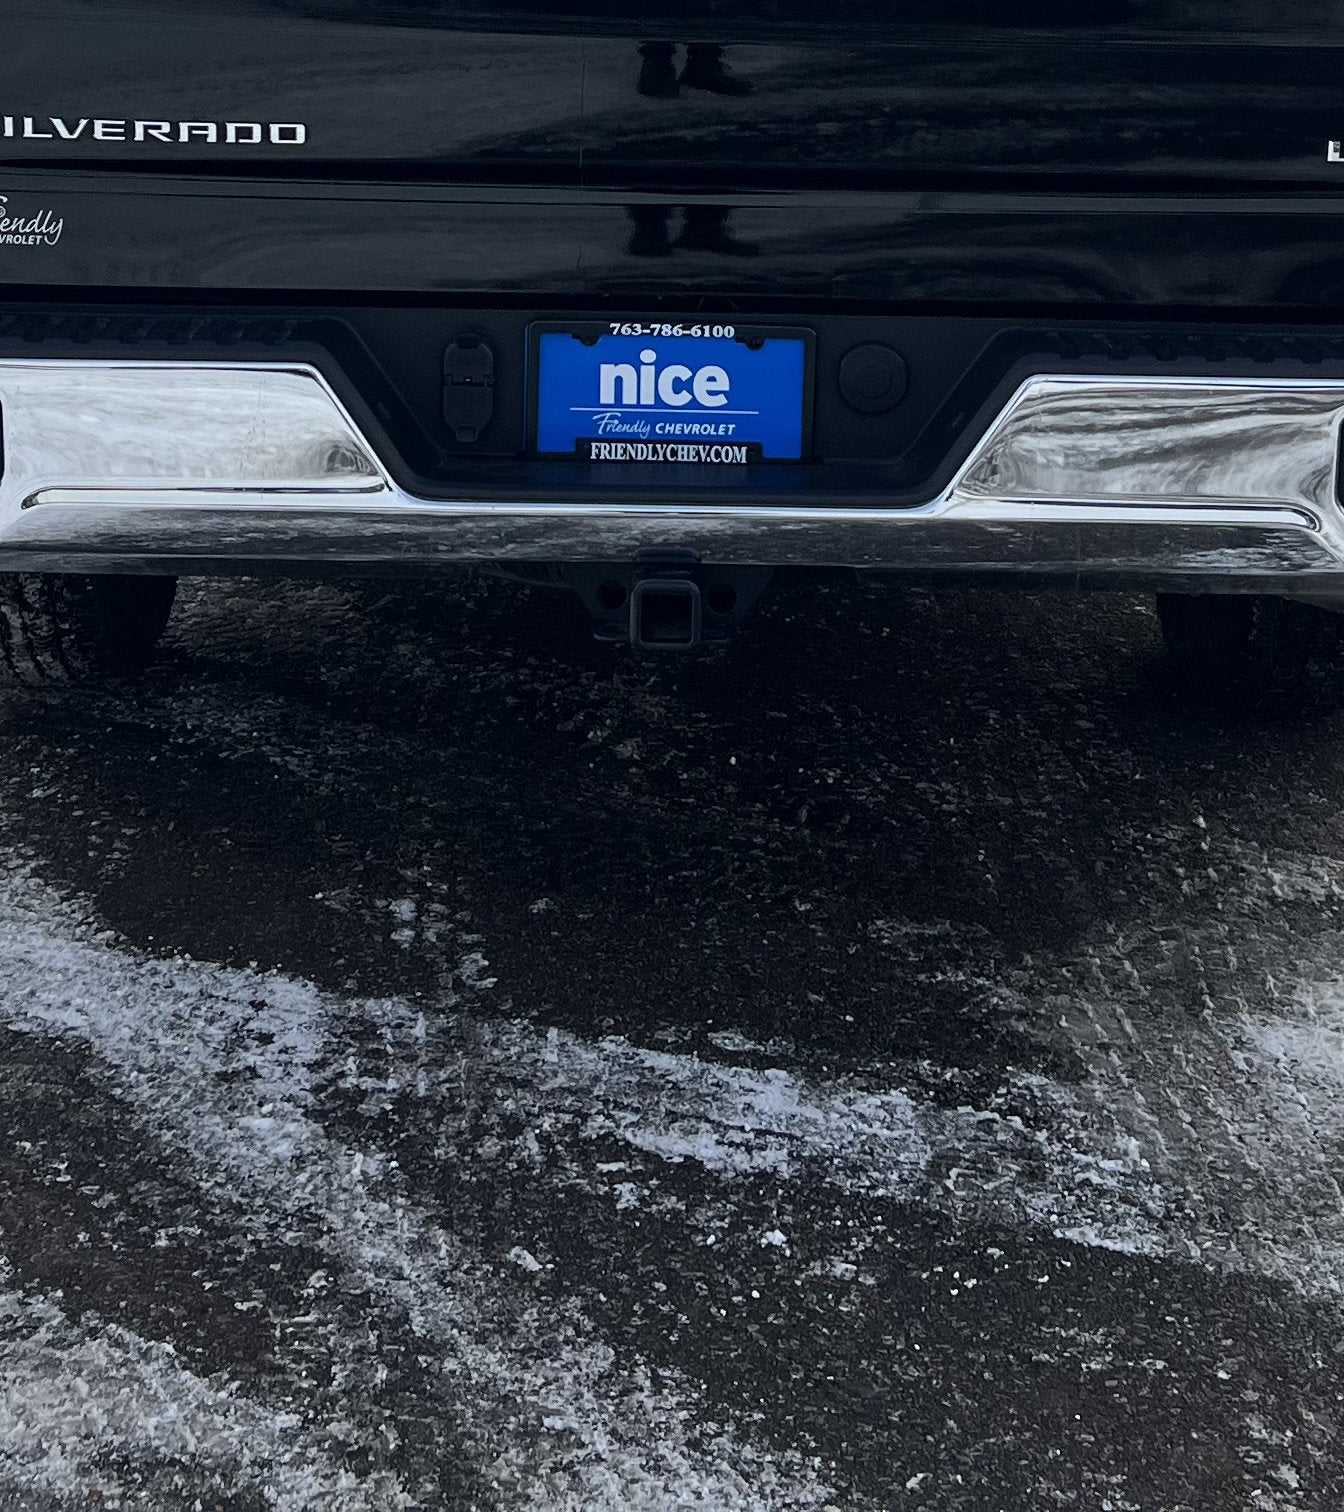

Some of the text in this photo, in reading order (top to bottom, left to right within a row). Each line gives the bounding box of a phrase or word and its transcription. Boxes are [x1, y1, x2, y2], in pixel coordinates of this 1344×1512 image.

[609, 322, 735, 338] 763-786-6100
[599, 349, 730, 407] nice
[592, 412, 736, 438] Friendly CHEVROLET
[590, 442, 747, 464] FRIENDLYCHEV.COM
